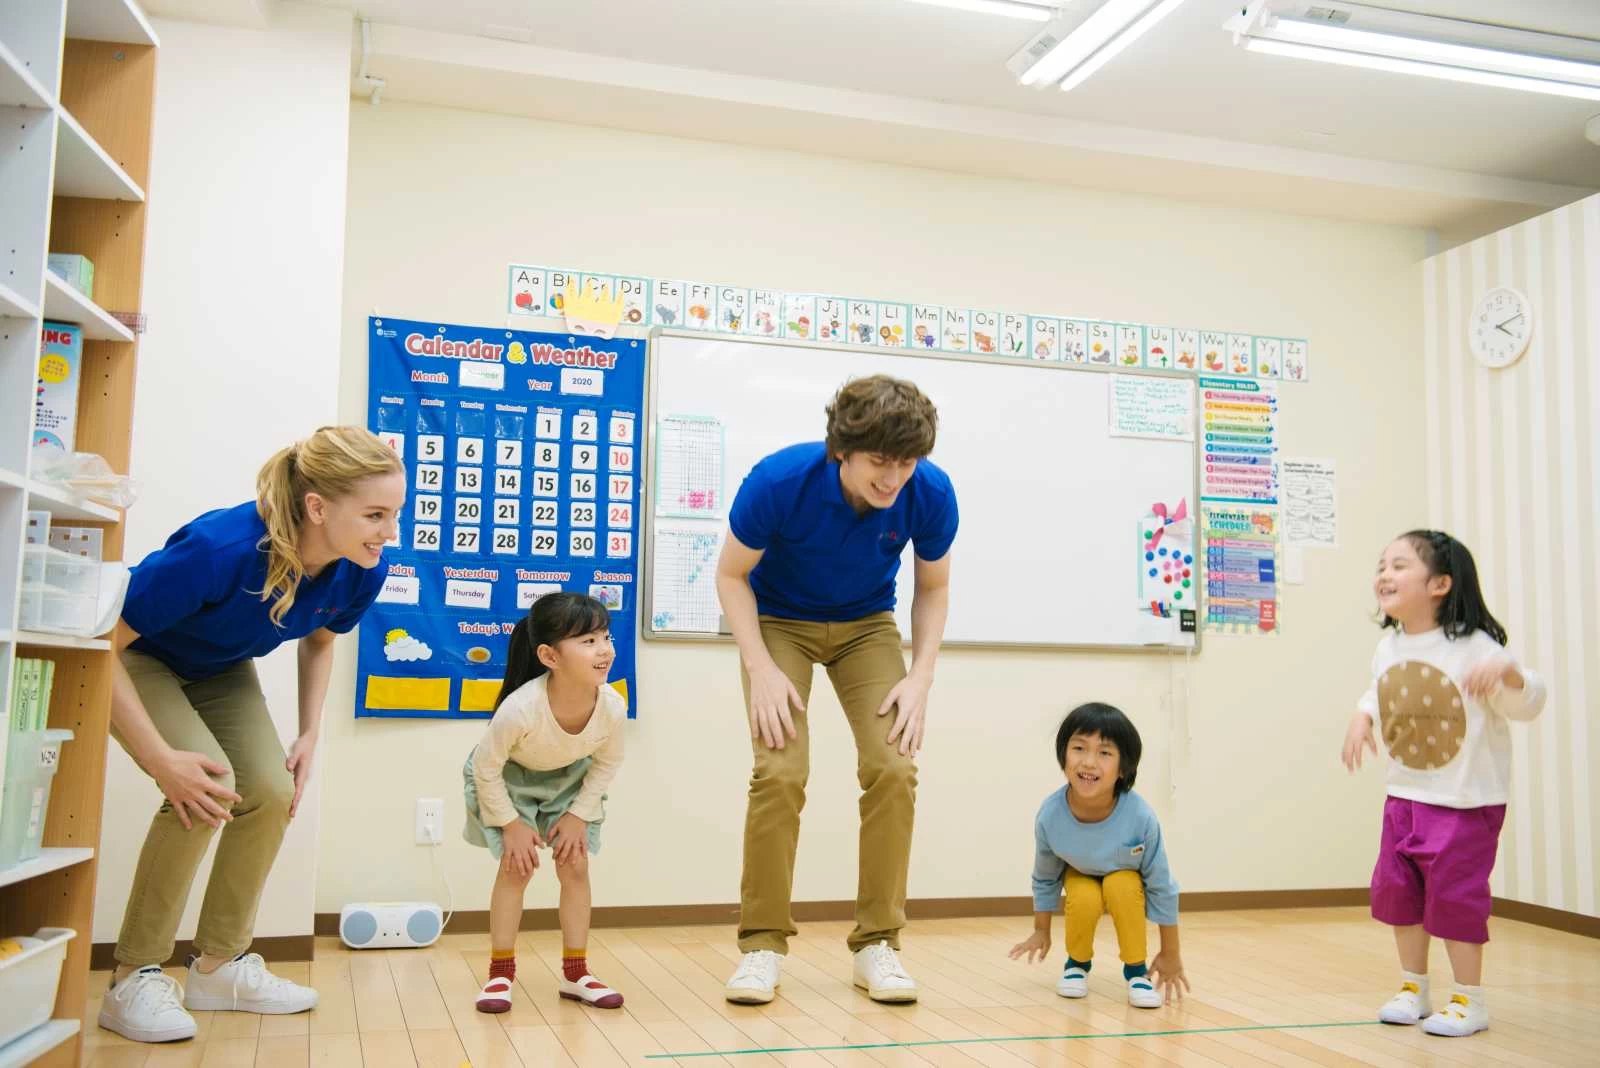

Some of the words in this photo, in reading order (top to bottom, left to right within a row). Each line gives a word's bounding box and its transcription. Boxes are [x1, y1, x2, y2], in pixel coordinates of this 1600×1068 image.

[517, 271, 539, 285] Aa
[621, 279, 641, 295] Dd
[659, 281, 678, 297] Ee
[691, 284, 710, 300] Ff
[722, 288, 743, 308] Gg
[823, 300, 839, 319] Jj
[853, 303, 871, 317] Kk
[884, 306, 898, 319] Ll
[915, 307, 938, 321] Mm
[946, 310, 964, 323] Nn
[976, 312, 994, 326] Oo
[1005, 315, 1022, 331] Pp
[1034, 319, 1055, 337] Qq
[1065, 322, 1081, 335] Rr
[1092, 325, 1108, 338] Ss
[1121, 327, 1136, 340] Tt
[1151, 328, 1168, 341] Uu
[1178, 331, 1194, 344] Vv
[1203, 334, 1224, 345] Ww
[1232, 336, 1247, 349] Xx
[1259, 341, 1275, 357] Yy
[1287, 342, 1301, 354] Zz
[406, 334, 503, 360] Calendar
[508, 342, 526, 364] &
[531, 345, 616, 369] Weather
[412, 370, 448, 384] Month
[528, 379, 552, 392] Year
[571, 376, 593, 387] 2020
[460, 401, 484, 411] Tuesday
[545, 419, 552, 433] 1
[580, 421, 590, 436] 2
[617, 421, 628, 437] 3
[425, 441, 436, 456] 5
[464, 443, 476, 458] 6
[504, 445, 515, 460] 7
[542, 448, 552, 463] 8
[580, 450, 590, 465] 9
[613, 451, 629, 466] 10
[420, 469, 439, 485] 12
[460, 472, 478, 488] 13
[499, 474, 517, 490] 14
[537, 476, 555, 492] 15
[575, 478, 592, 493] 16
[613, 480, 629, 495] 17
[419, 500, 438, 516] 19
[457, 502, 479, 518] 20
[498, 504, 515, 519] 21
[535, 506, 555, 521] 22
[573, 507, 593, 522] 23
[611, 509, 631, 523] 24
[1209, 511, 1249, 521] ELEMENTARY
[416, 529, 438, 545] 26
[456, 532, 477, 547] 27
[496, 533, 517, 549] 28
[534, 535, 555, 550] 29
[572, 536, 594, 551] 30
[611, 537, 627, 551] 31
[388, 565, 415, 578] oday
[445, 567, 498, 581] Yesterday
[517, 569, 570, 582] Tomorrow
[594, 571, 632, 582] Season
[385, 585, 408, 594] Friday
[453, 589, 485, 599] Thursday
[523, 591, 543, 600] Satur
[459, 622, 499, 636] Today's
